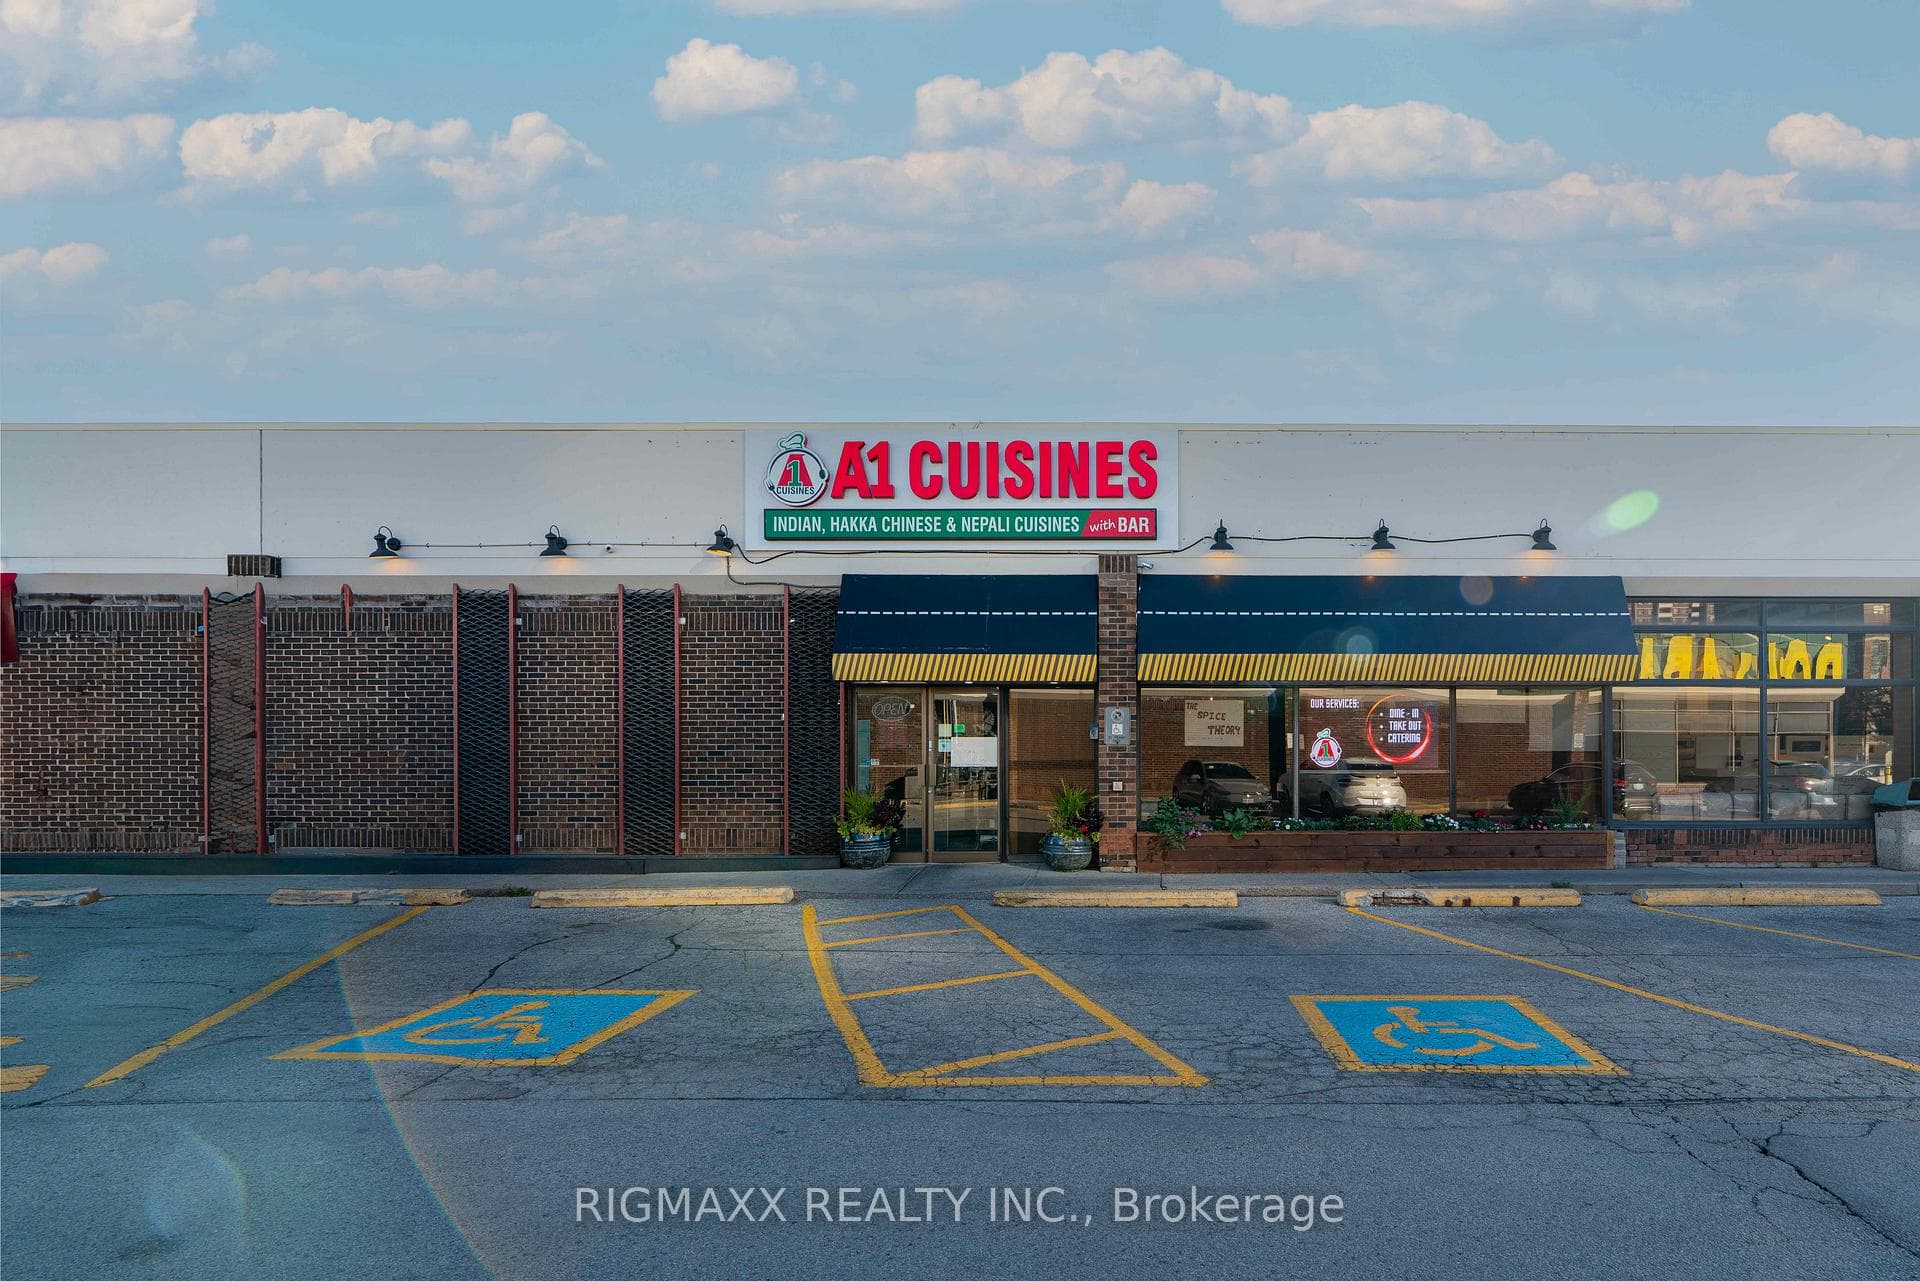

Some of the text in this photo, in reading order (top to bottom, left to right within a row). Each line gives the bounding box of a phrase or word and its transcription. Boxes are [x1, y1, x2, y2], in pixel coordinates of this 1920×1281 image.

[830, 440, 1158, 500] A1 CUISINES
[776, 486, 815, 495] CUISINES
[773, 516, 1150, 534] INDIAN, HAKKA CHINESE & NEPALI CUISINES with BAR
[1186, 702, 1198, 710] THE
[1310, 699, 1360, 709] OUR SERVICES:
[874, 703, 907, 716] OPEN
[1389, 708, 1405, 718] DINE
[1197, 711, 1226, 721] SPICE
[1207, 725, 1241, 735] THEORY
[1389, 721, 1422, 730] TAKE OUT
[1388, 733, 1421, 743] CATERING
